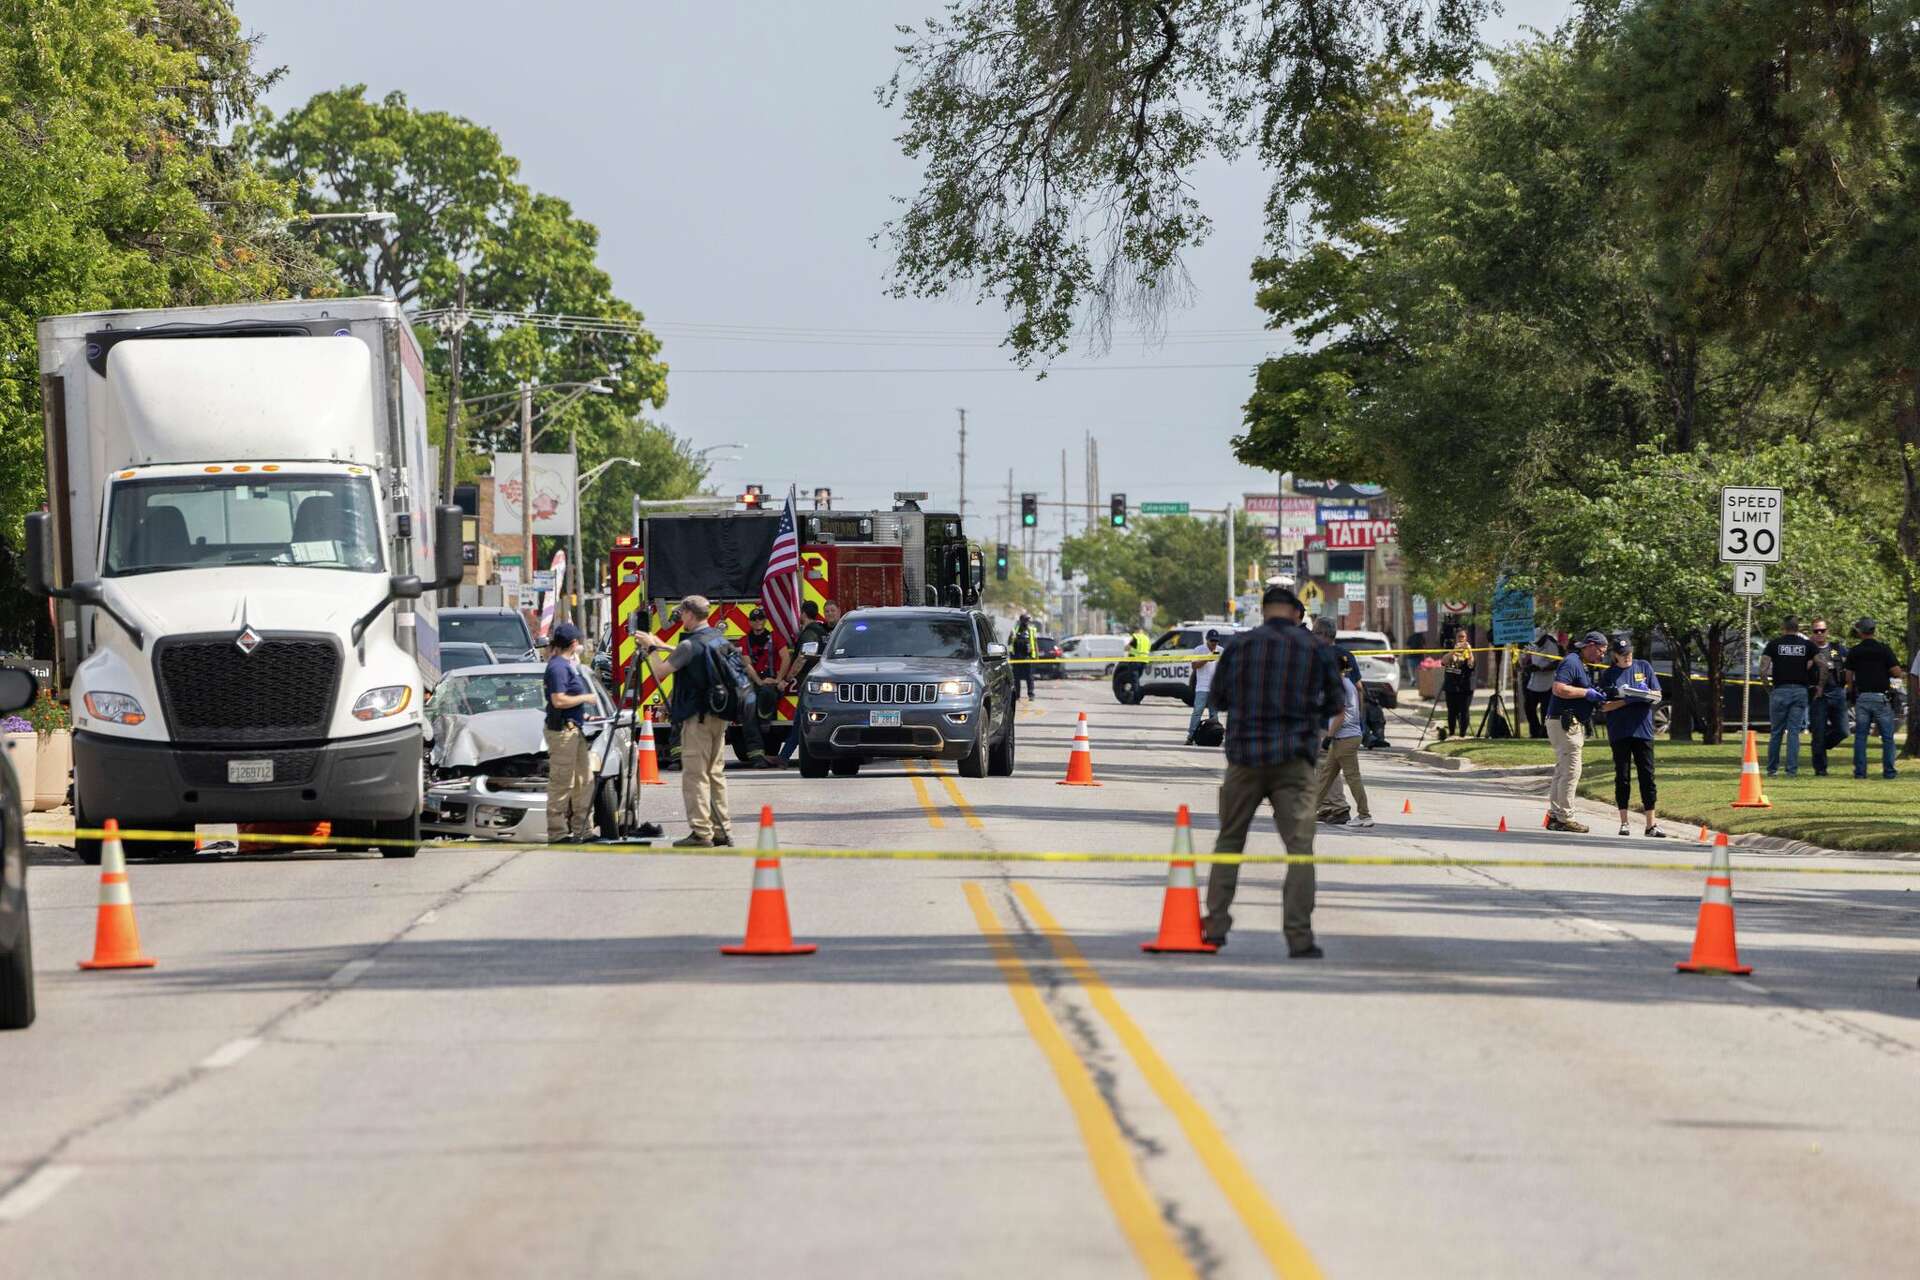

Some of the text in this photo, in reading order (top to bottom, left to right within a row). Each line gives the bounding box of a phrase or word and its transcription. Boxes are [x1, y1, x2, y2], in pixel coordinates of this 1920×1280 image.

[1728, 496, 1777, 508] SPEED
[1321, 510, 1349, 521] WINGS
[1733, 511, 1771, 523] LIMIT
[1727, 528, 1775, 555] 30
[1780, 645, 1803, 655] POLICE
[1154, 666, 1190, 679] POLICE
